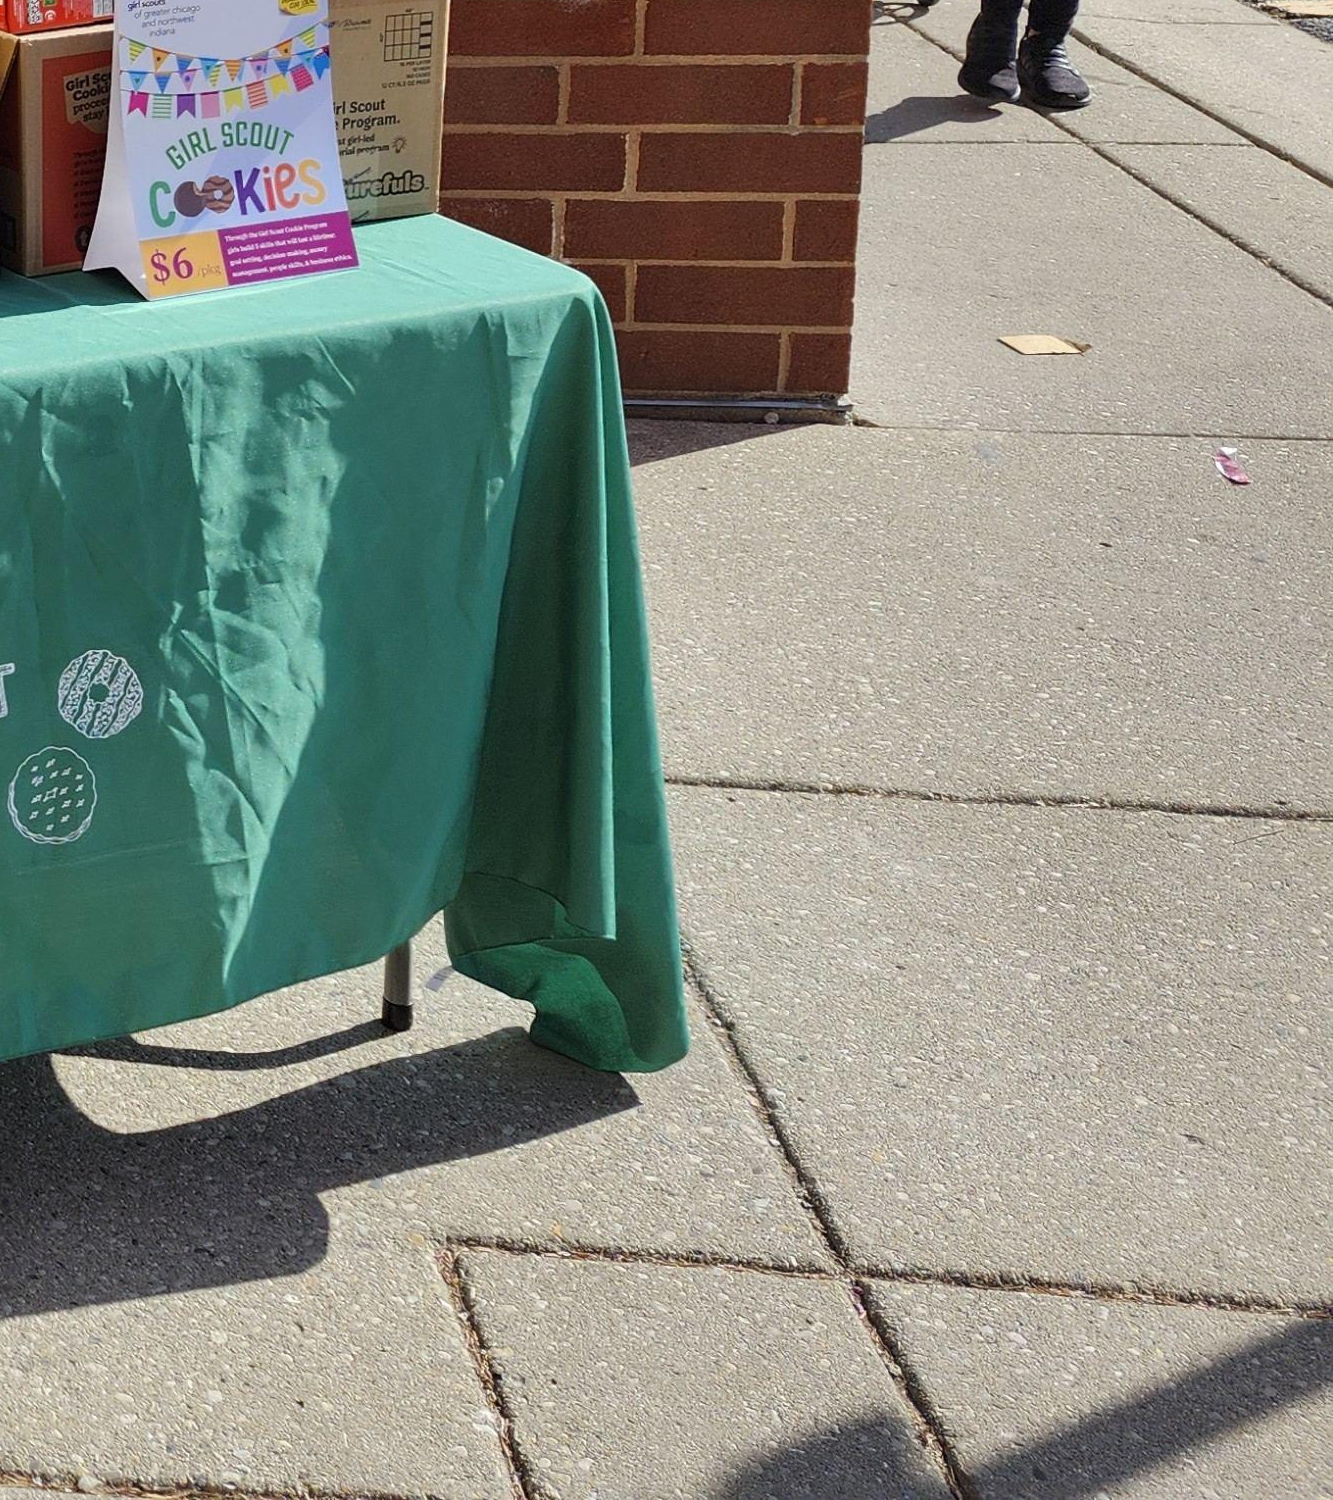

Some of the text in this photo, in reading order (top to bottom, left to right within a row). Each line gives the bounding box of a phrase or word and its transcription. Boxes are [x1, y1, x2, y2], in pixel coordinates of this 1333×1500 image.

[128, 0, 165, 12] girl scouts
[172, 5, 201, 14] chicago
[66, 75, 89, 91] Girl
[350, 99, 385, 113] Scout
[166, 121, 294, 171] GIRL SCOUT
[150, 247, 193, 285] $6
